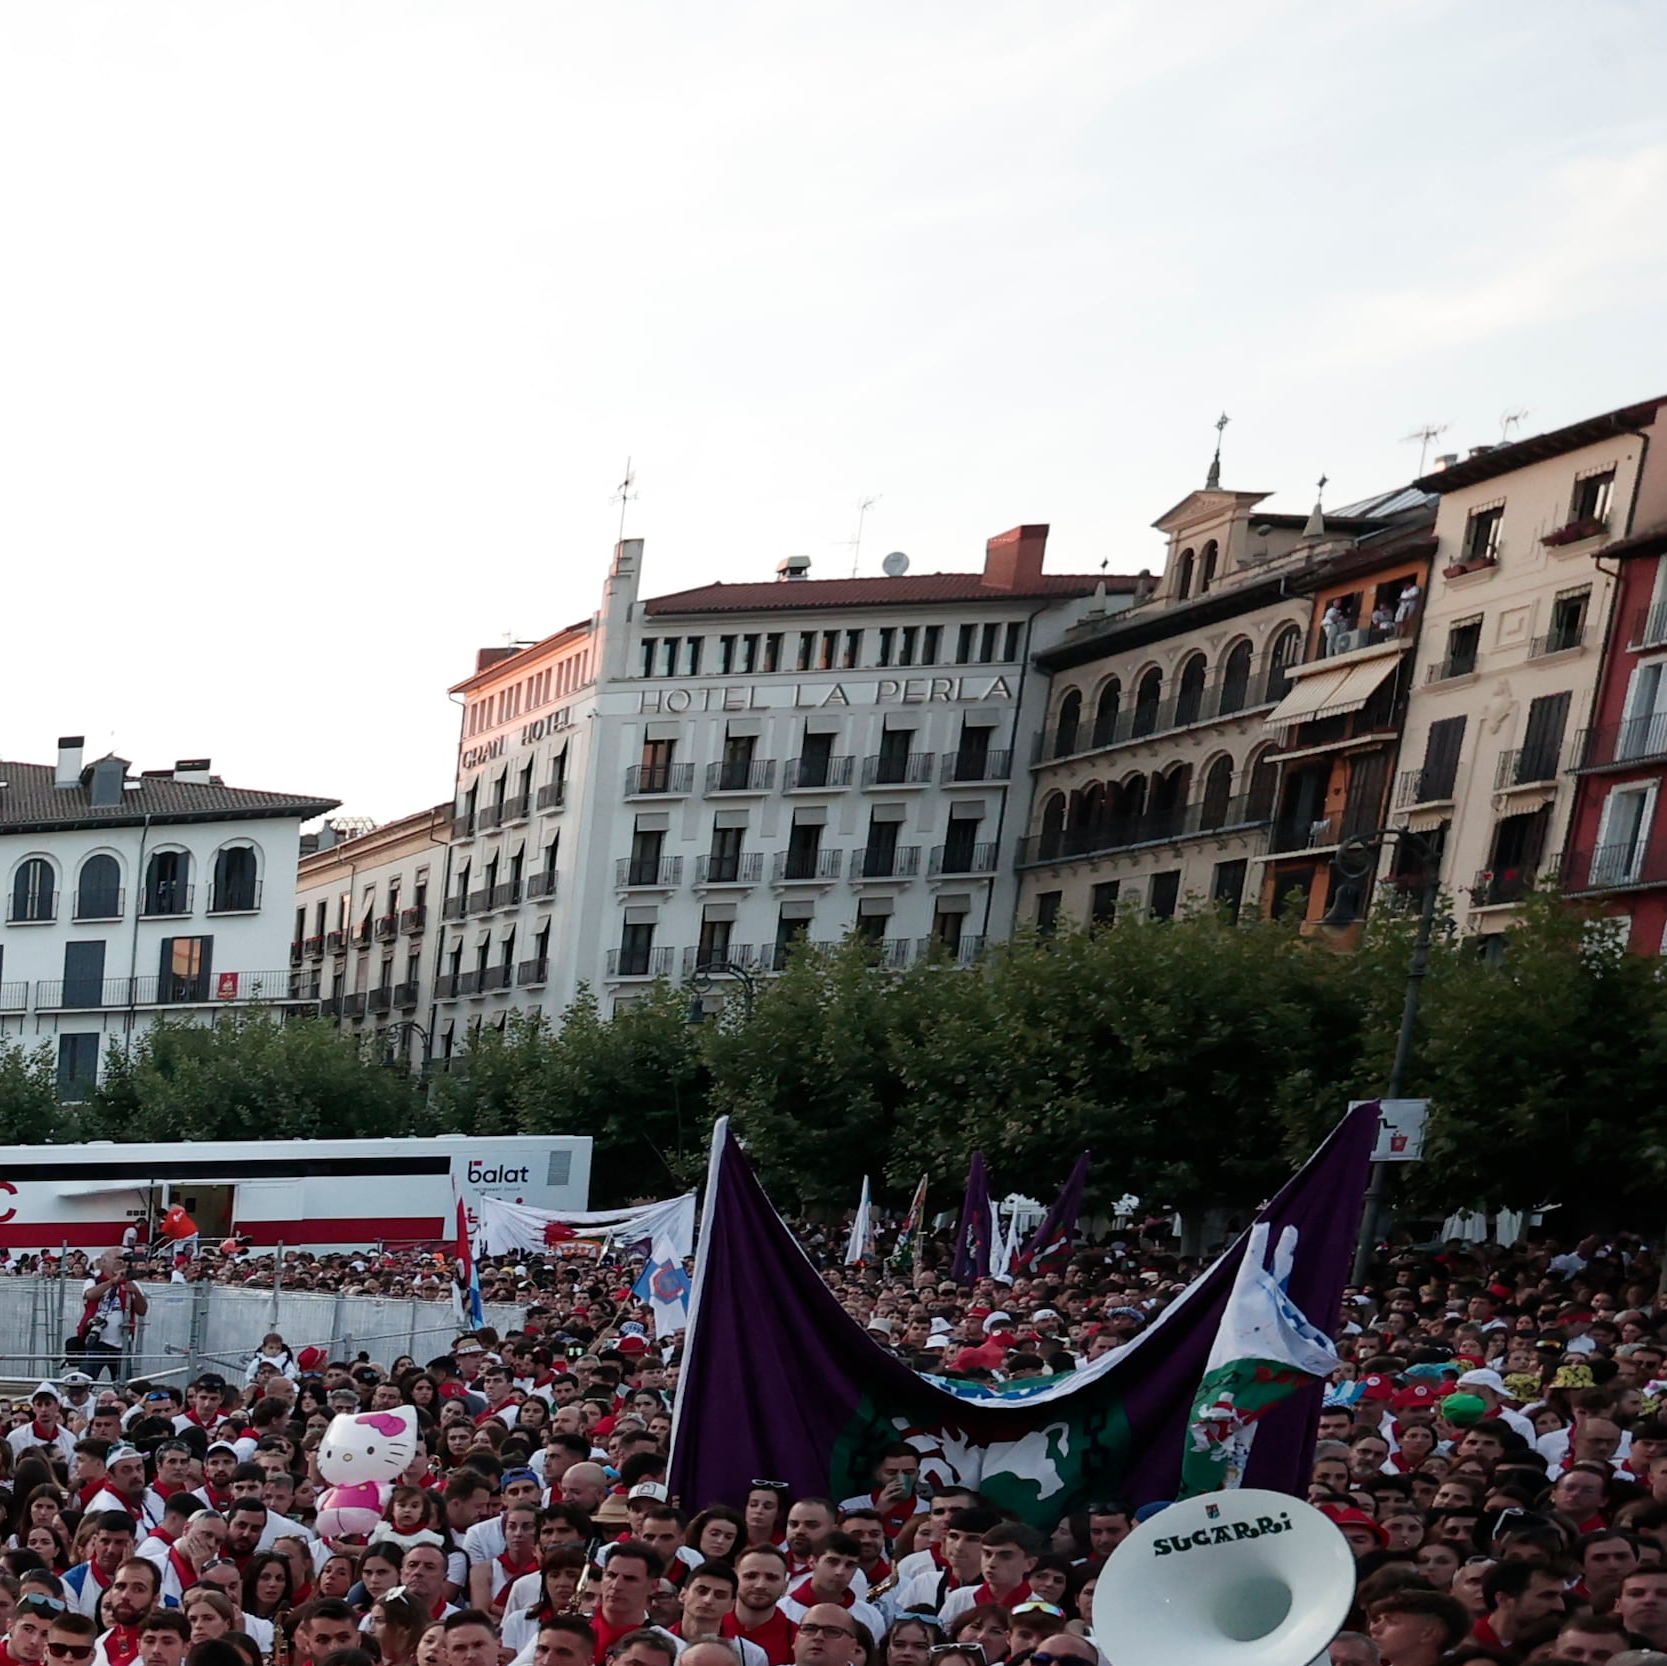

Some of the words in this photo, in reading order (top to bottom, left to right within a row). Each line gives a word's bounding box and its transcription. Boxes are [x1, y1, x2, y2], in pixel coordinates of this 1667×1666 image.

[639, 685, 771, 714] HOTEL
[794, 682, 850, 708] LA
[875, 675, 1013, 705] PERLA
[462, 734, 506, 769] GRAN
[521, 706, 579, 746] HOTEL
[468, 1160, 529, 1183] balat
